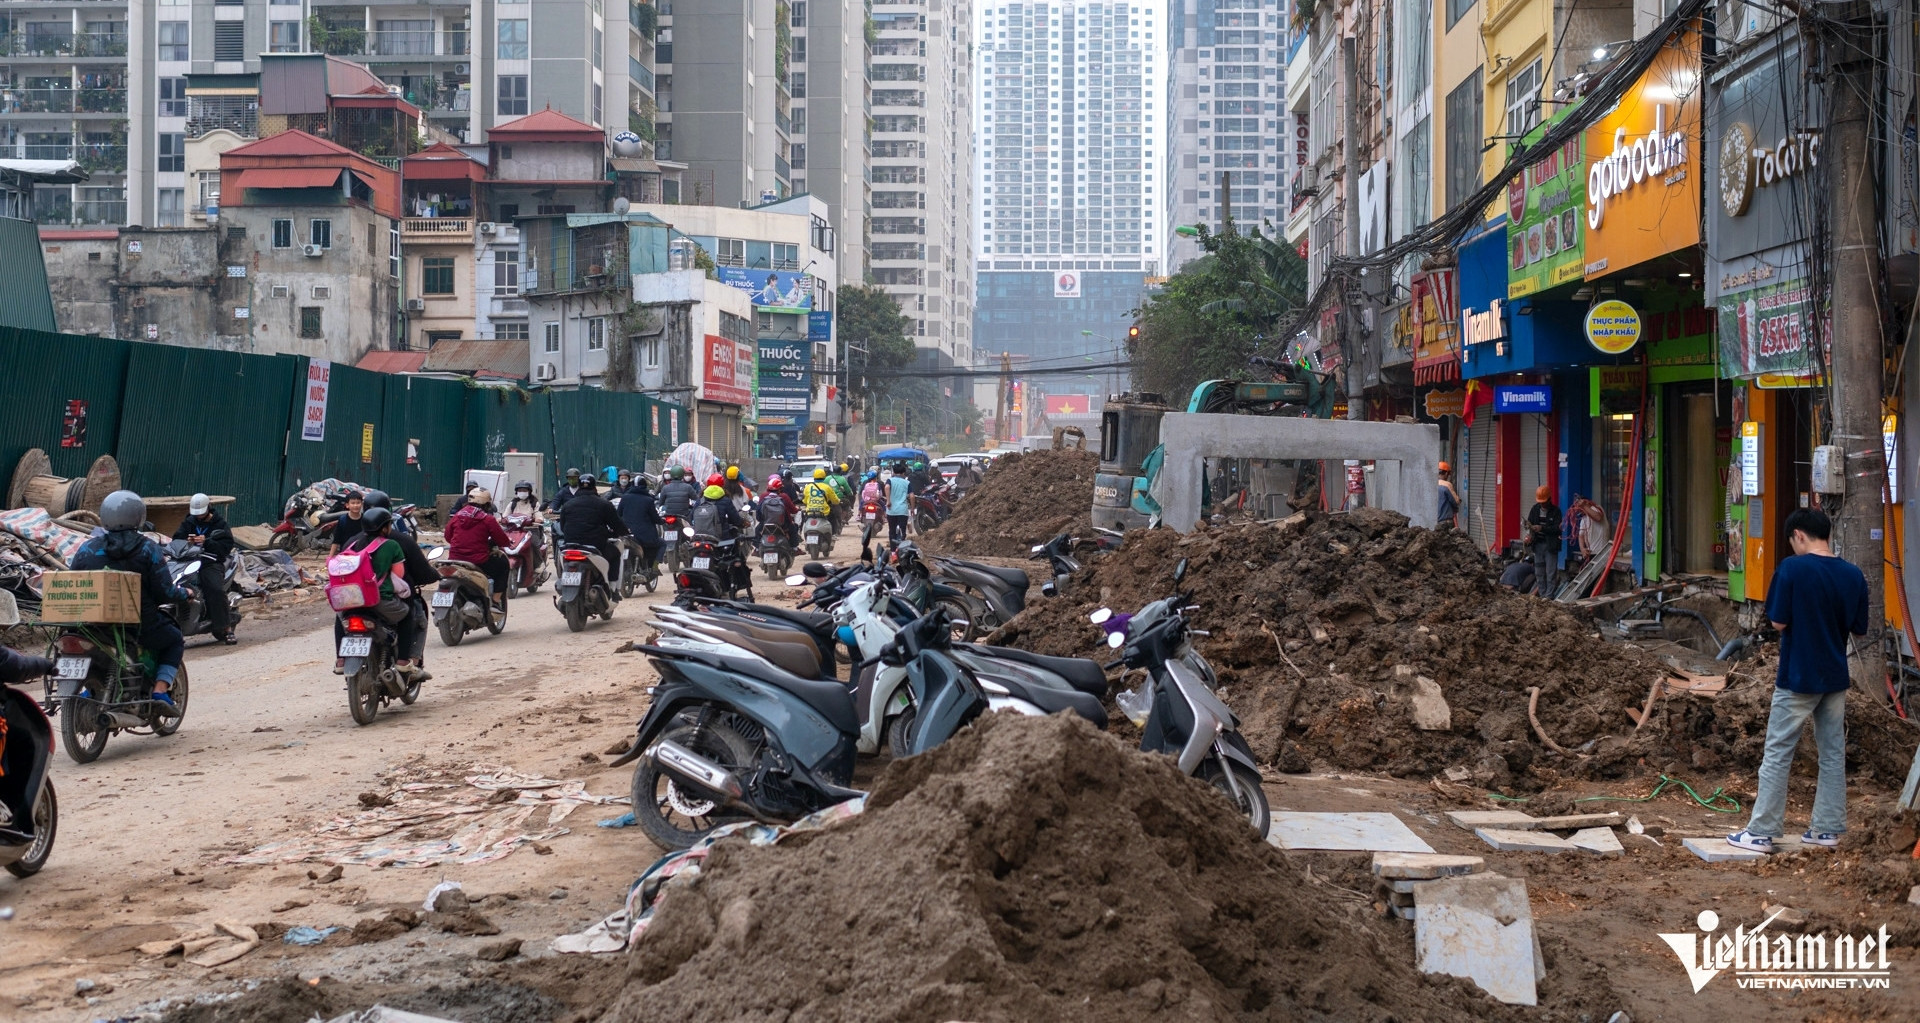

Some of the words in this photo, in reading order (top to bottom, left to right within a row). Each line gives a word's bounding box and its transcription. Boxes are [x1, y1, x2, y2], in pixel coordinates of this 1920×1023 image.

[1296, 113, 1308, 168] KORE
[1588, 103, 1686, 230] gofood.vn
[1462, 298, 1504, 346] Vinamilk
[1592, 317, 1613, 327] THỰC
[1592, 328, 1614, 338] NHẬP
[1759, 315, 1789, 357] 25K
[712, 342, 733, 364] ENEOS
[759, 344, 802, 360] THUỐC
[309, 361, 321, 381] RỬA
[322, 367, 329, 383] XE
[309, 384, 326, 402] NƯỚC
[1502, 391, 1546, 403] Vinamilk
[307, 406, 323, 424] SẠCH
[1096, 486, 1117, 497] OBELCO
[52, 579, 74, 590] NGỌC
[75, 579, 93, 588] LINH
[47, 590, 78, 601] TRƯỜNG
[79, 592, 99, 600] SINH
[341, 647, 368, 655] 749.33
